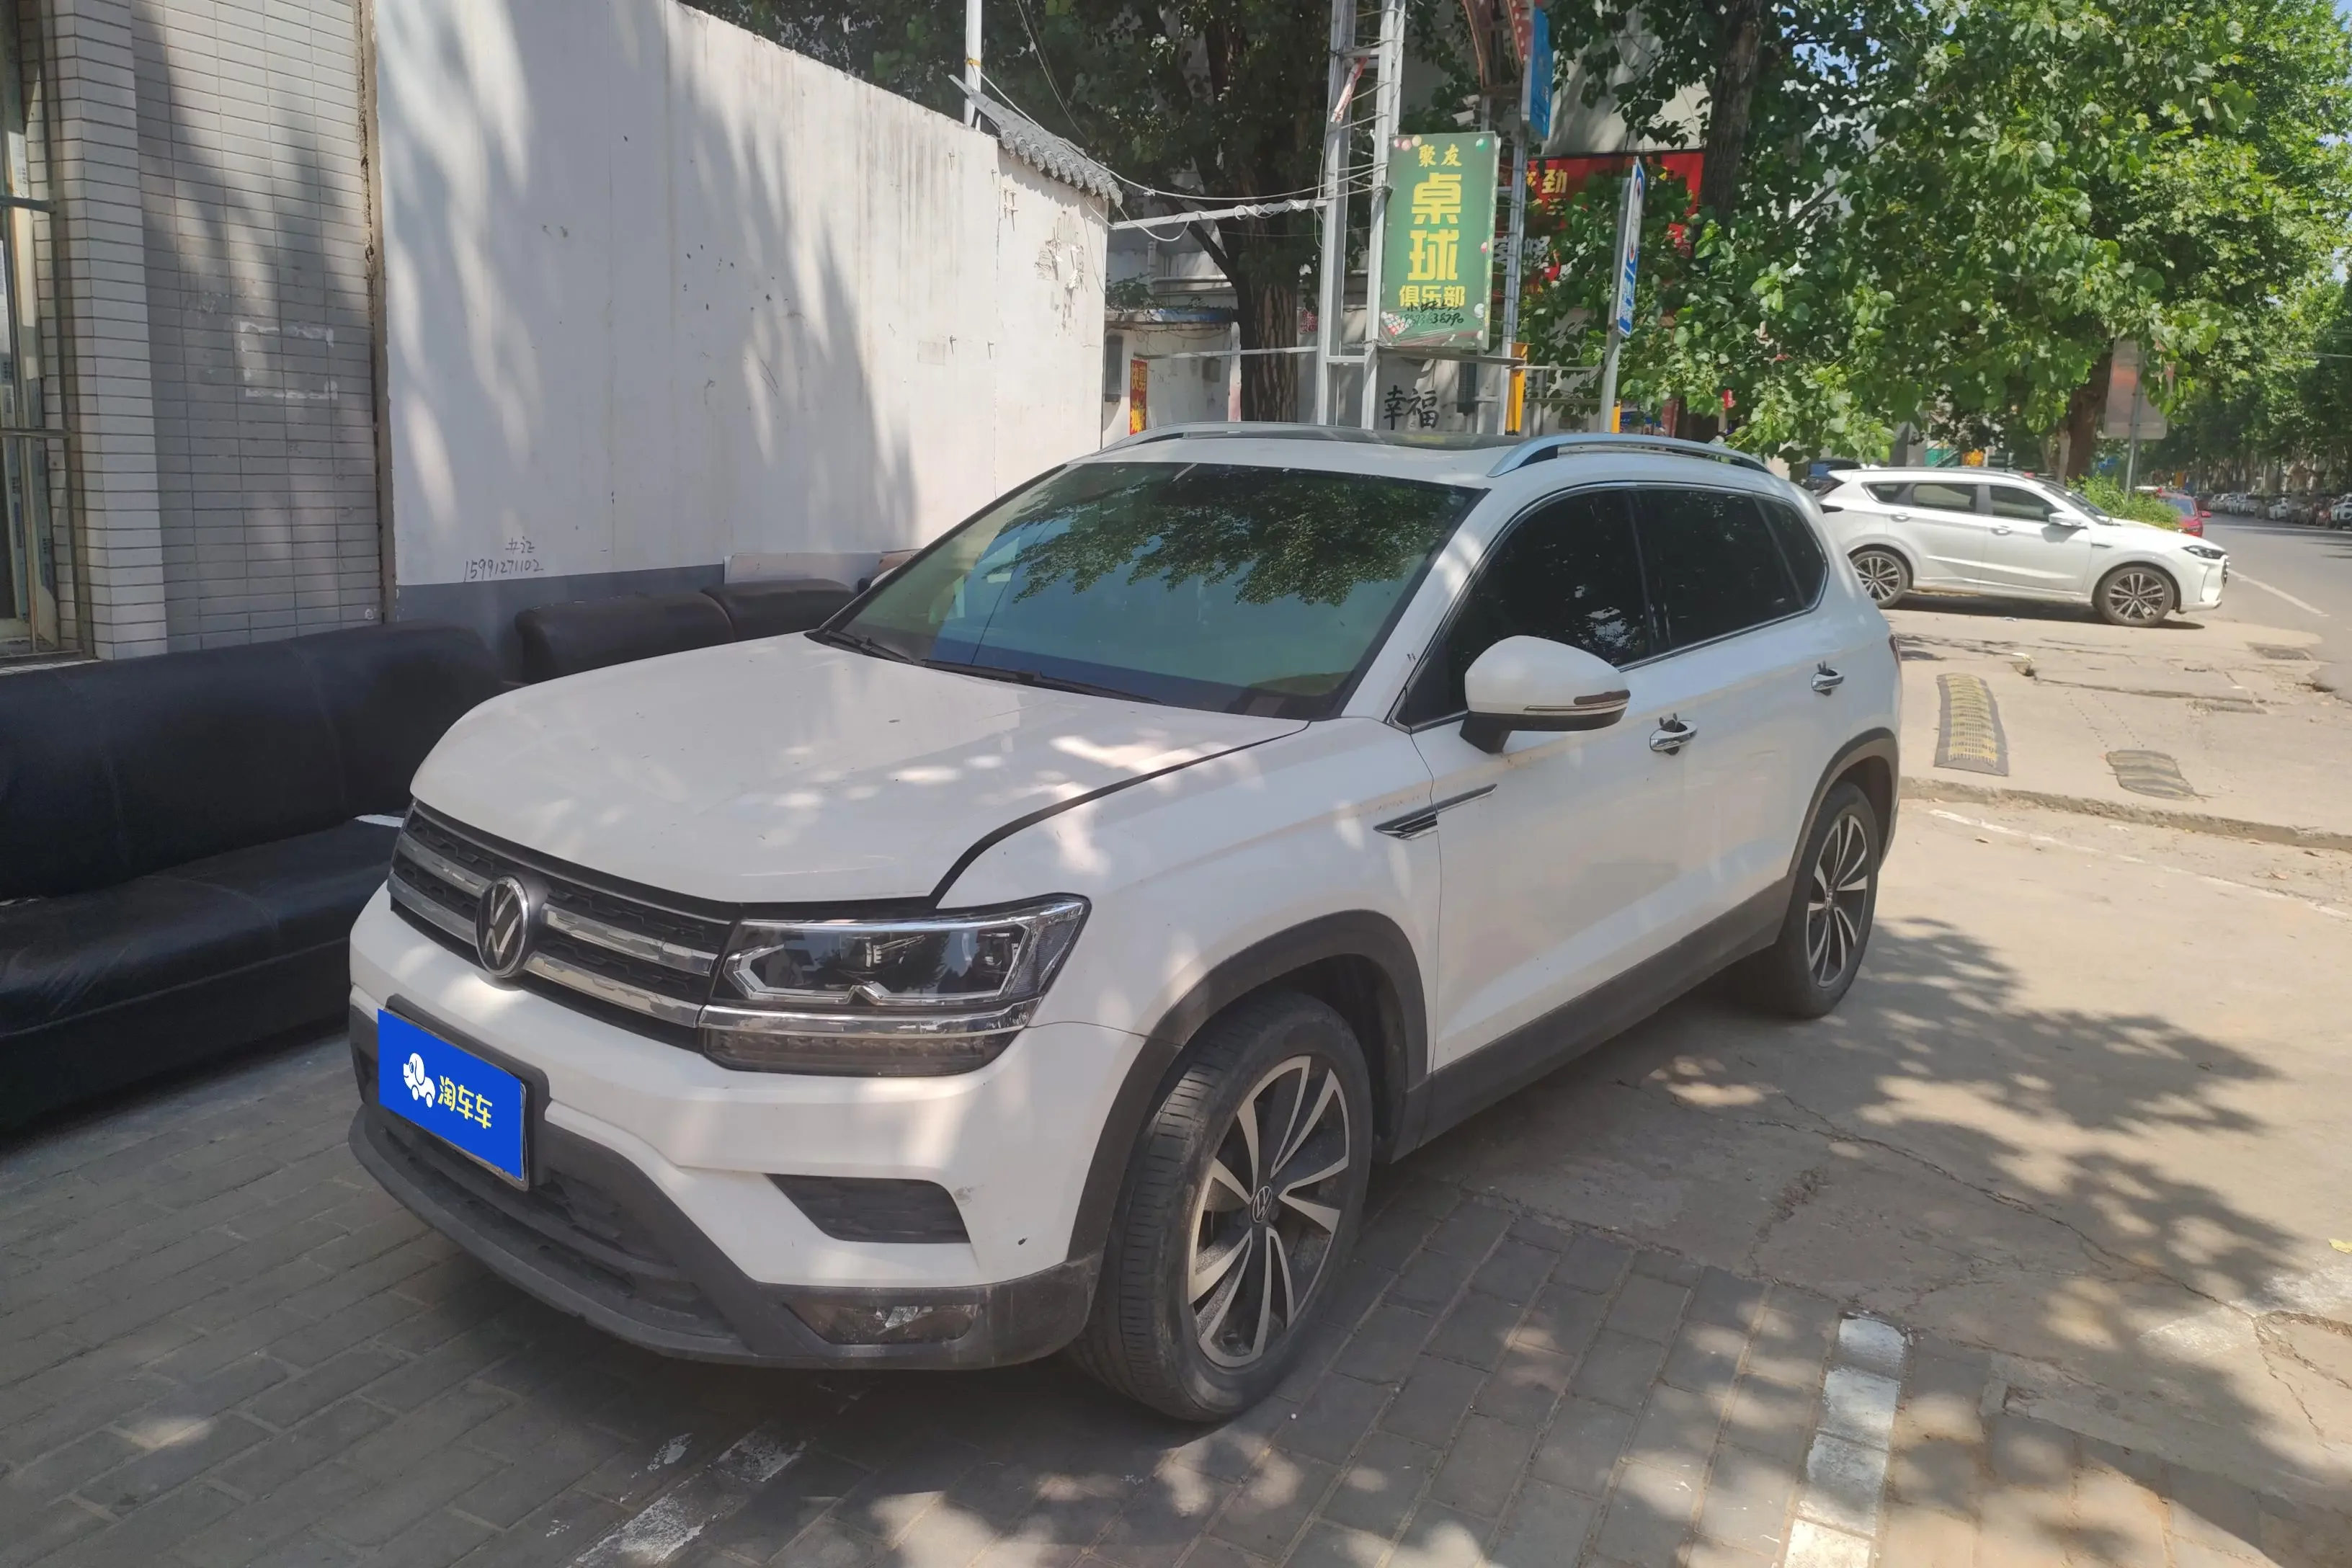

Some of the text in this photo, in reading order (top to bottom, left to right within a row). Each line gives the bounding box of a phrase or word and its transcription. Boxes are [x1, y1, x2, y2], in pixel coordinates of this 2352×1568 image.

[1419, 143, 1462, 168] 聚友
[1407, 172, 1462, 280] 桌球
[1399, 285, 1466, 308] 俱乐部
[1384, 385, 1440, 430] 幸福
[463, 559, 544, 582] 15991271102
